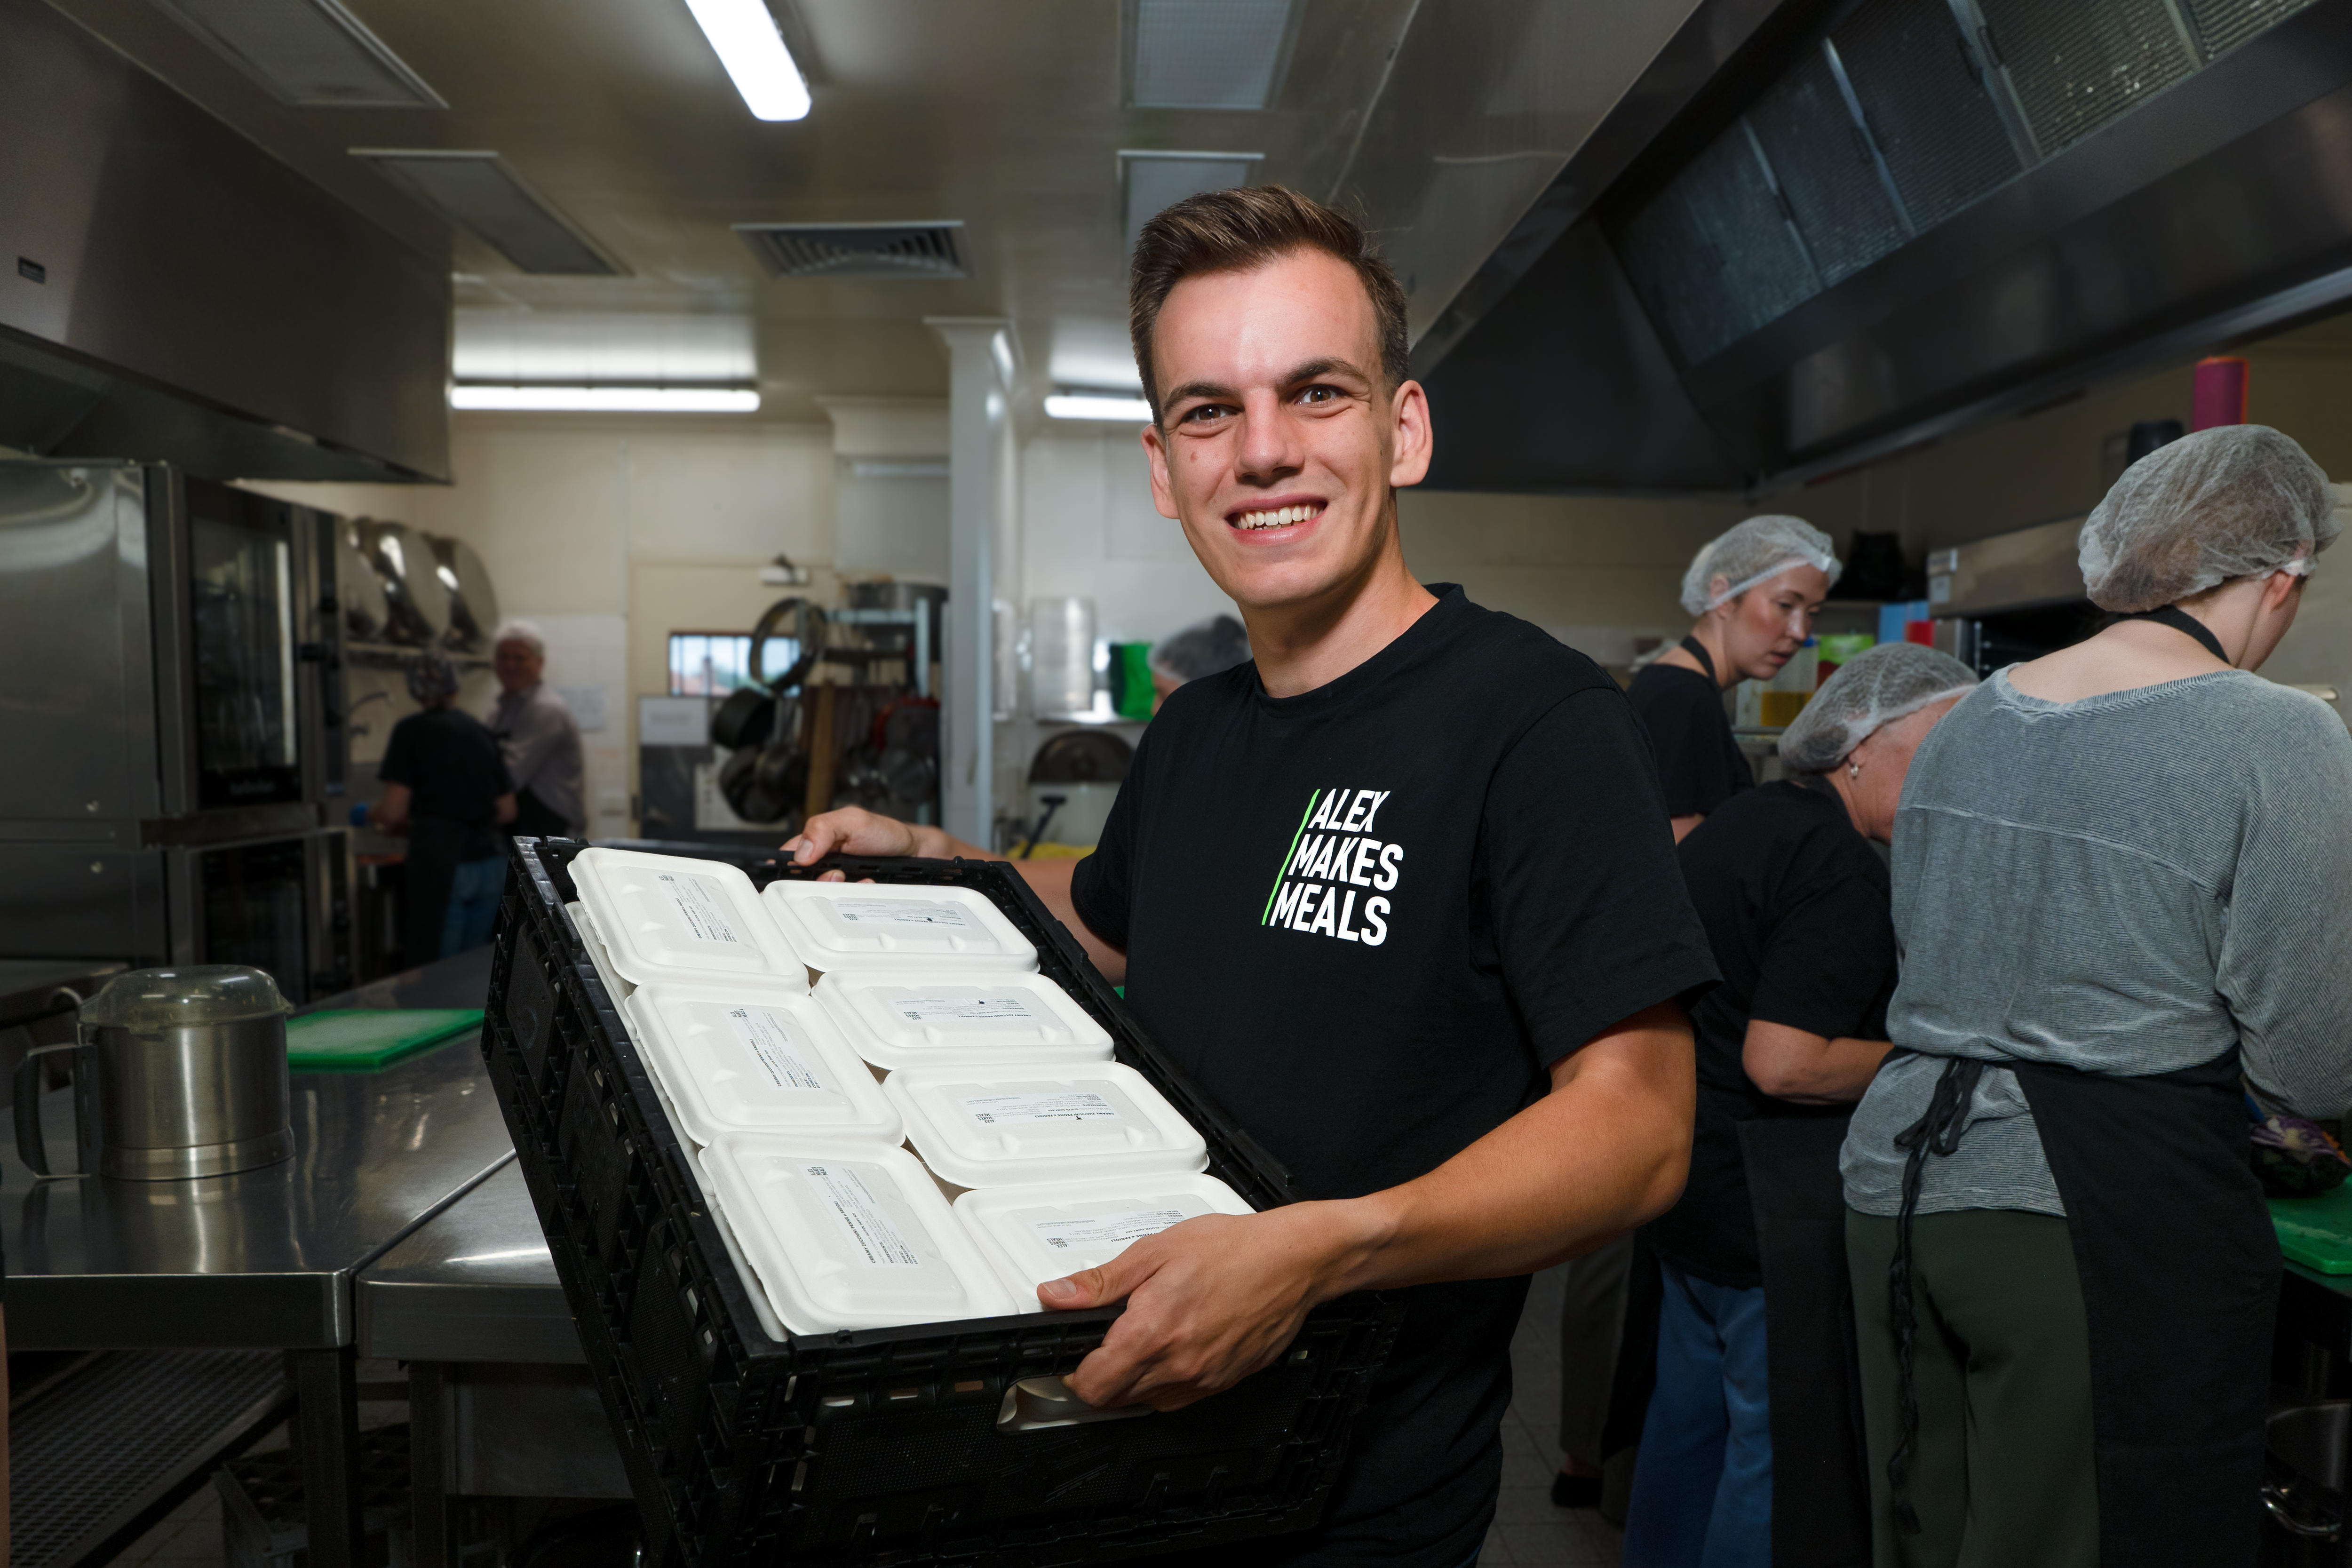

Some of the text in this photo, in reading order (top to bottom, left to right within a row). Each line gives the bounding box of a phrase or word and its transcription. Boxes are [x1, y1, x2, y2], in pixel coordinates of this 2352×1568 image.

[1308, 788, 1391, 832] ALEX
[1288, 834, 1404, 891] MAKES
[1270, 881, 1391, 946] MEALS
[771, 1074, 783, 1087] CREAMY
[811, 1166, 822, 1175] MAKES
[817, 1166, 828, 1175] MEALS
[833, 1201, 845, 1213] FAGIOLI
[843, 1217, 856, 1228] PENNE
[850, 1229, 867, 1246] ZUCCHINI
[862, 1247, 878, 1263] CREAMY
